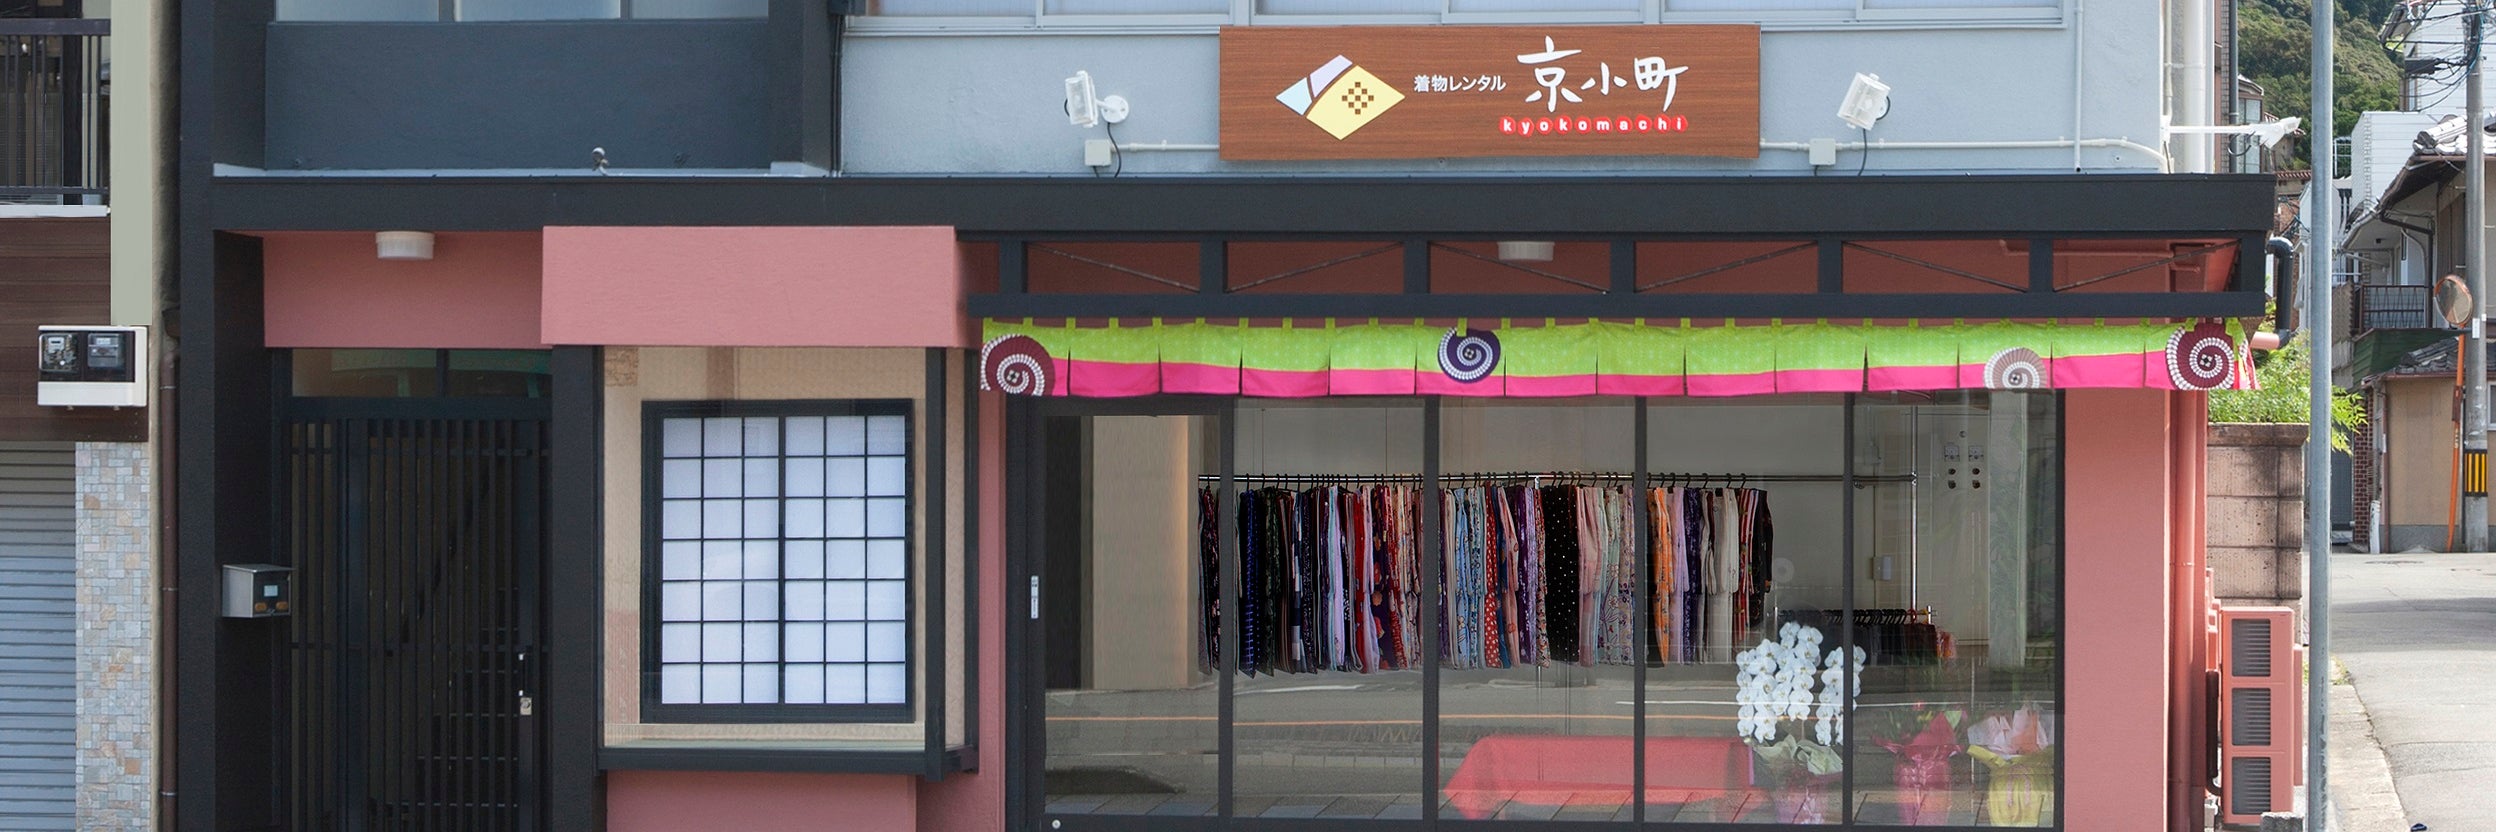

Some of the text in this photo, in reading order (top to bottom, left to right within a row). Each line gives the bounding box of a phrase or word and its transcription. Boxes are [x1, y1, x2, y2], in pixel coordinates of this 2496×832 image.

[1414, 35, 1689, 112] 着物レンタル 京小町
[1502, 116, 1684, 135] kyokomachi
